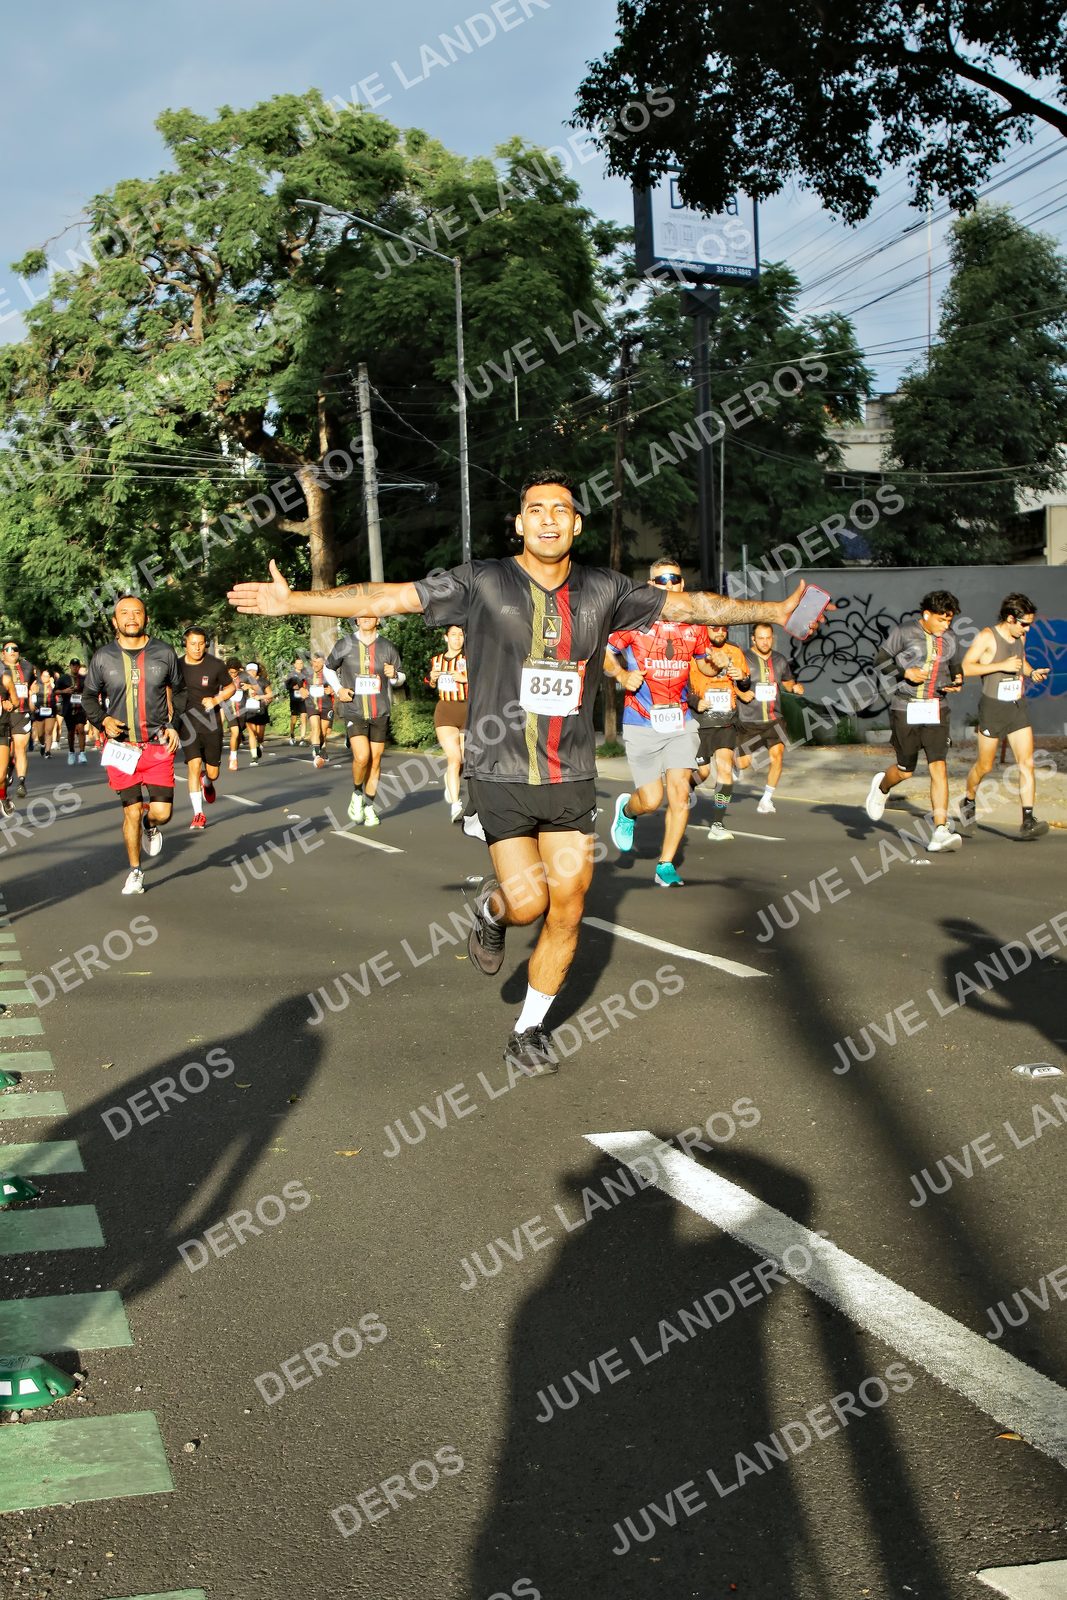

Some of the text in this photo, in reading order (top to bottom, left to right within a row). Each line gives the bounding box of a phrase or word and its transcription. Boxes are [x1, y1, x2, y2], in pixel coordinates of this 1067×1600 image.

[644, 657, 690, 669] Emirate
[530, 676, 574, 697] 8545
[653, 711, 681, 723] 10691
